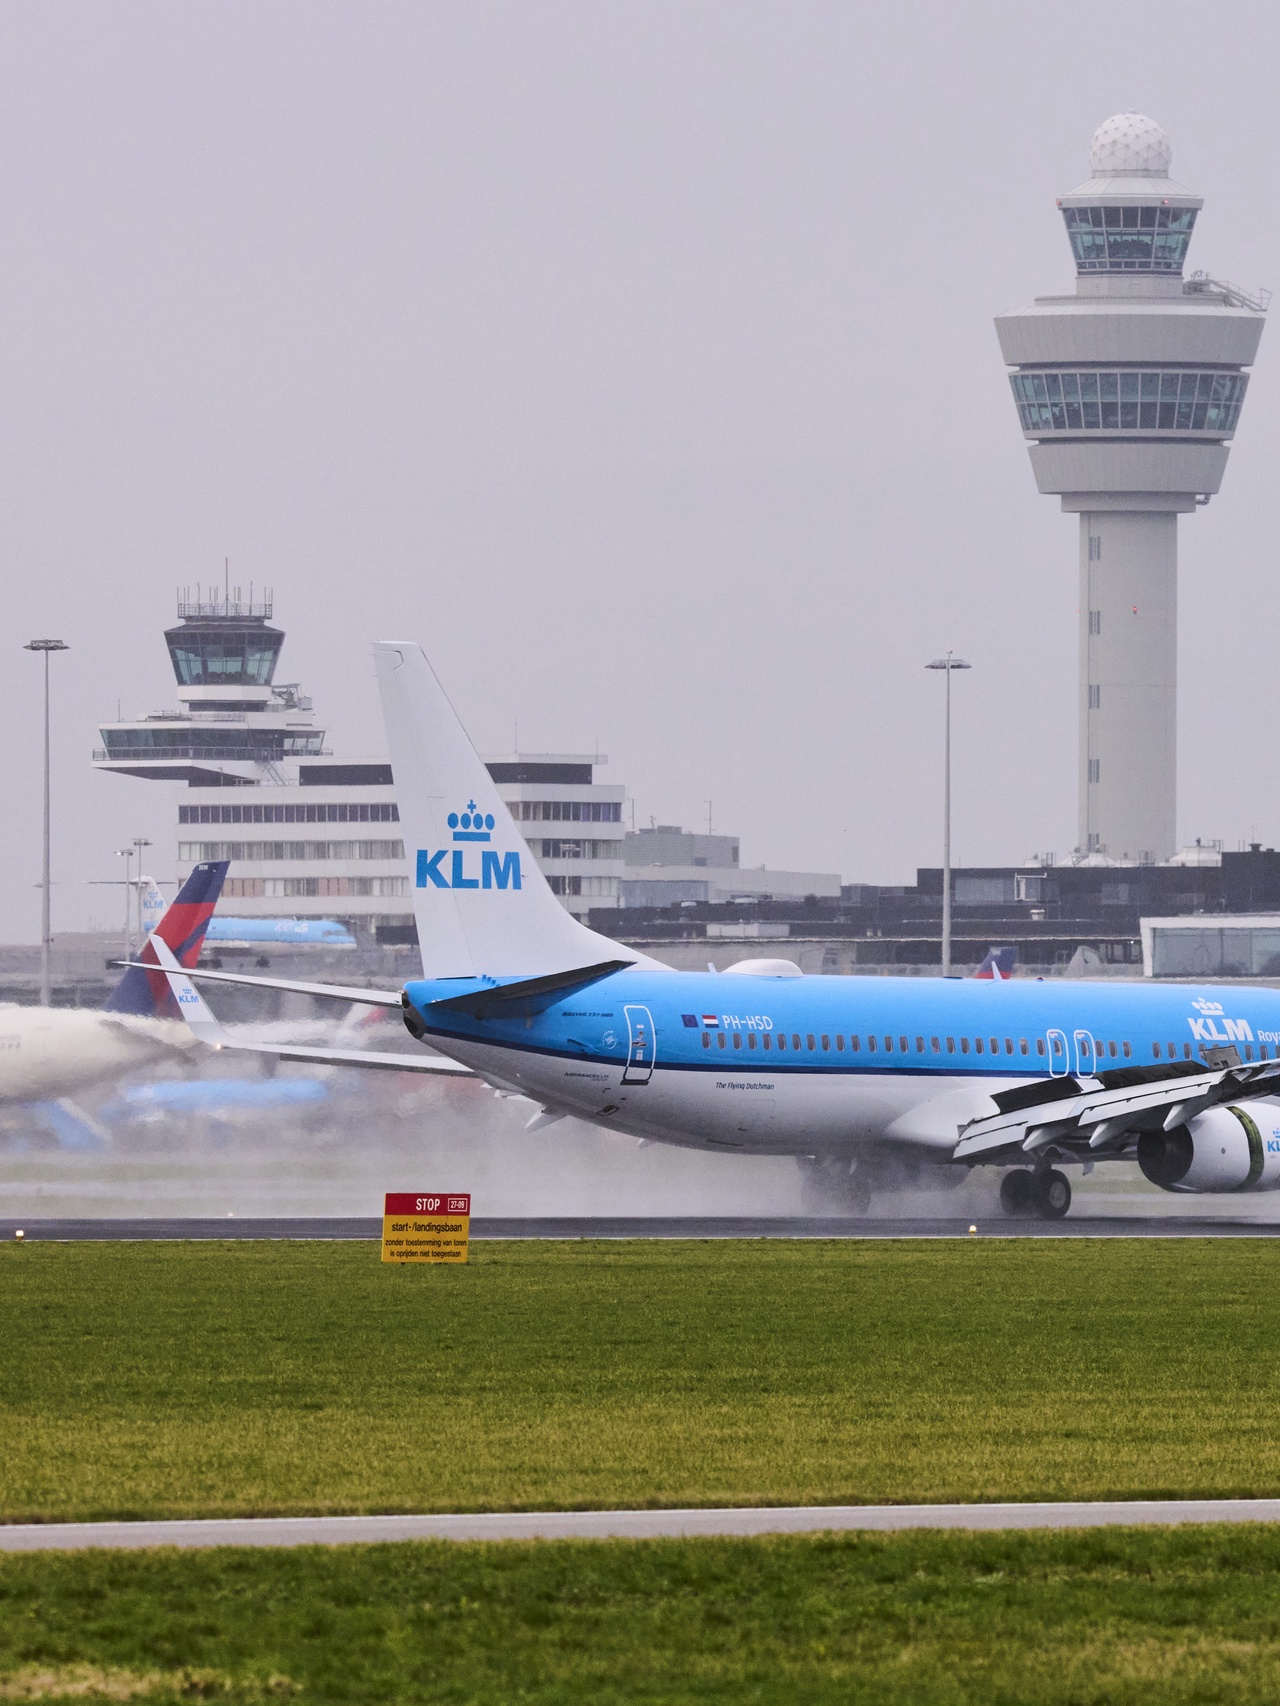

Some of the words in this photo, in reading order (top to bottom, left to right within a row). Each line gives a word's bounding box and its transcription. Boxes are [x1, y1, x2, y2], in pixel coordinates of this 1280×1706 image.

[416, 850, 522, 890] KLM
[143, 900, 164, 909] KLM
[179, 995, 199, 1003] KLM
[722, 1015, 773, 1030] PH-HSD
[1187, 1017, 1254, 1042] KLM
[727, 1082, 746, 1091] Flying
[745, 1082, 775, 1090] Dutchman
[415, 1198, 441, 1211] STOP
[450, 1200, 464, 1209] 27-09
